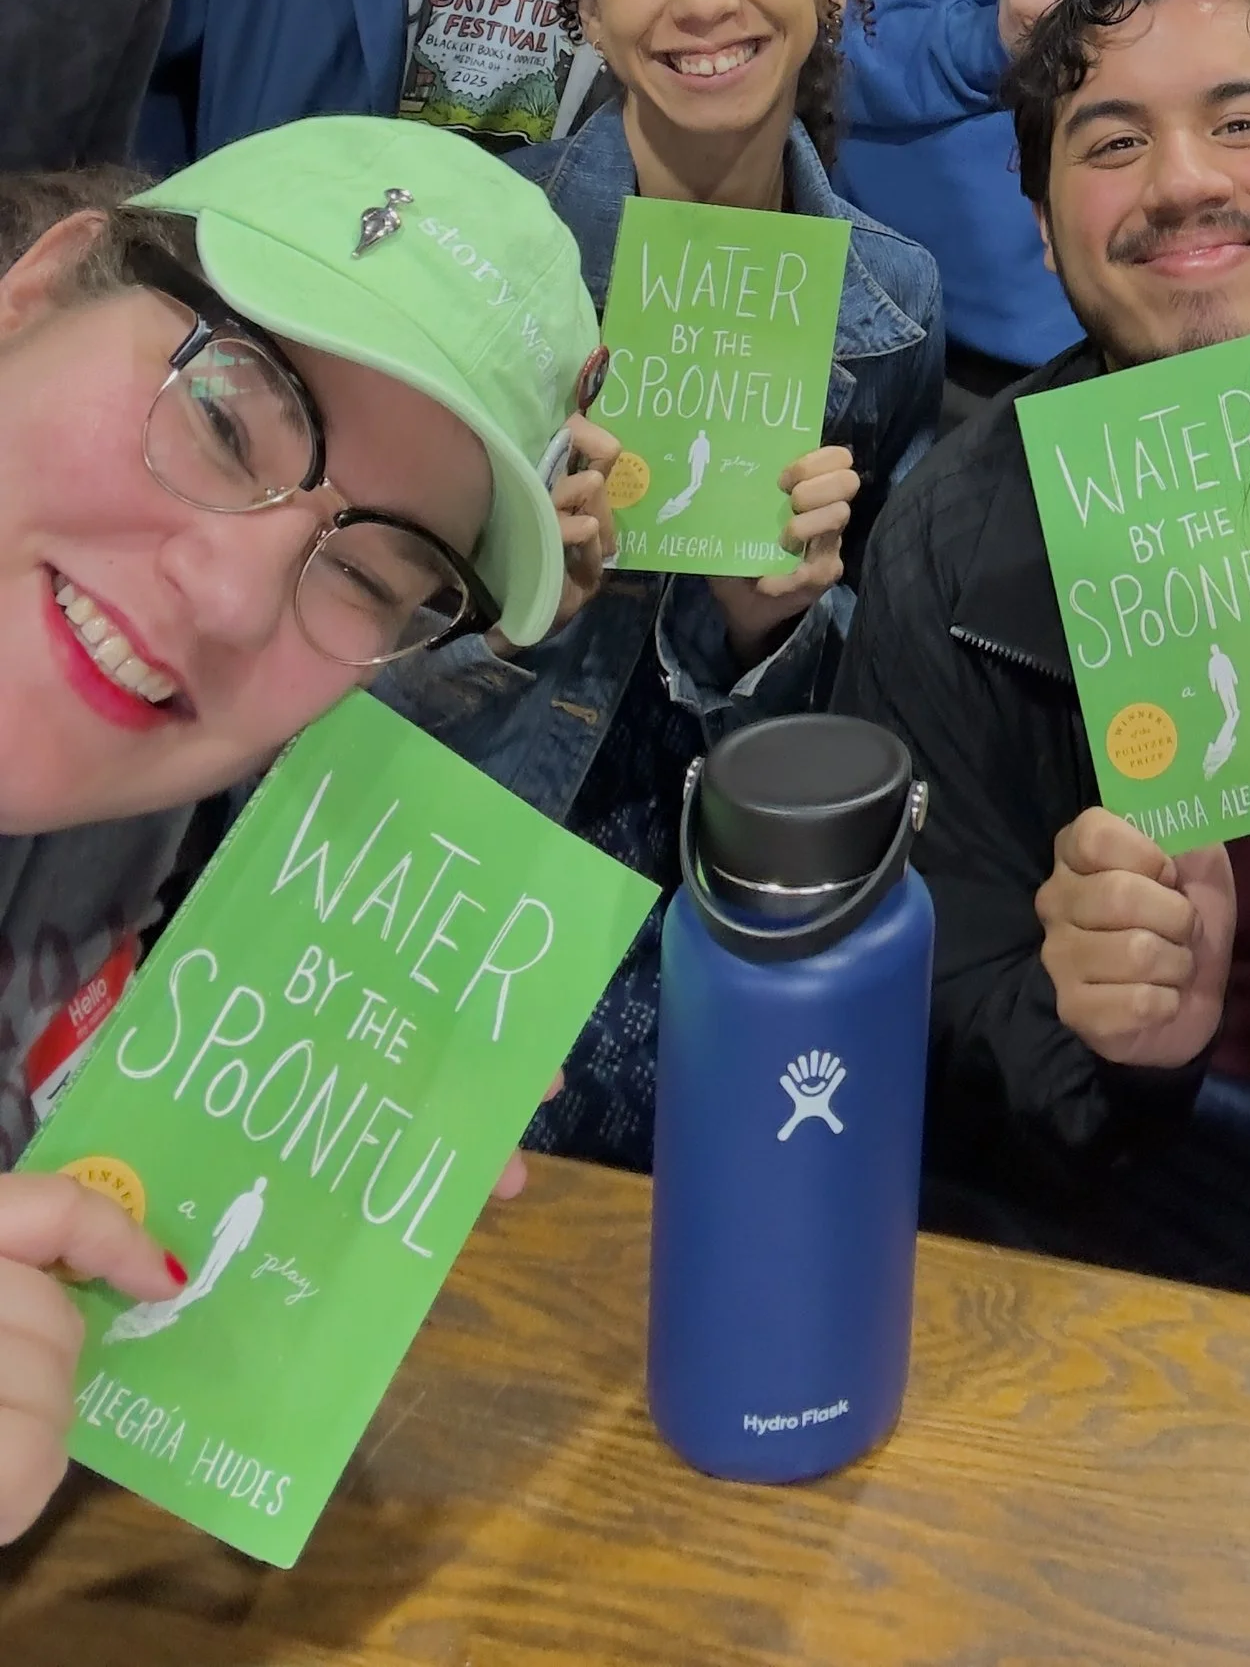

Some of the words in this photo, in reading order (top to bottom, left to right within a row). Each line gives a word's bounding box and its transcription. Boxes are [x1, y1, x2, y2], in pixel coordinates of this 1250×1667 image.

[426, 33, 457, 51] BLACK
[443, 14, 549, 53] FESTIVAL
[451, 71, 488, 87] 2025
[418, 216, 517, 307] story
[641, 238, 808, 327] WATER
[671, 323, 705, 356] BY
[712, 329, 753, 358] THE
[600, 348, 811, 432] SPOONFUL
[663, 451, 676, 463] a
[719, 456, 760, 476] play
[615, 530, 648, 555] ARA
[656, 533, 724, 559] ALEGRÍA
[733, 541, 787, 561] HUDES
[1128, 518, 1166, 565] BY
[1177, 505, 1235, 550] THE
[1181, 685, 1195, 700] a
[270, 770, 556, 1042] WATER
[67, 978, 108, 1028] Hello
[286, 944, 354, 1013] BY
[347, 987, 418, 1065] THE
[116, 946, 459, 1260] SPOONFUL
[72, 1169, 134, 1215] INNE
[177, 1199, 197, 1221] a
[252, 1251, 322, 1319] play
[742, 1412, 799, 1437] Hydro
[801, 1398, 850, 1428] Flask
[74, 1370, 187, 1466] ALEGRÍA
[189, 1436, 292, 1517] HUDES
